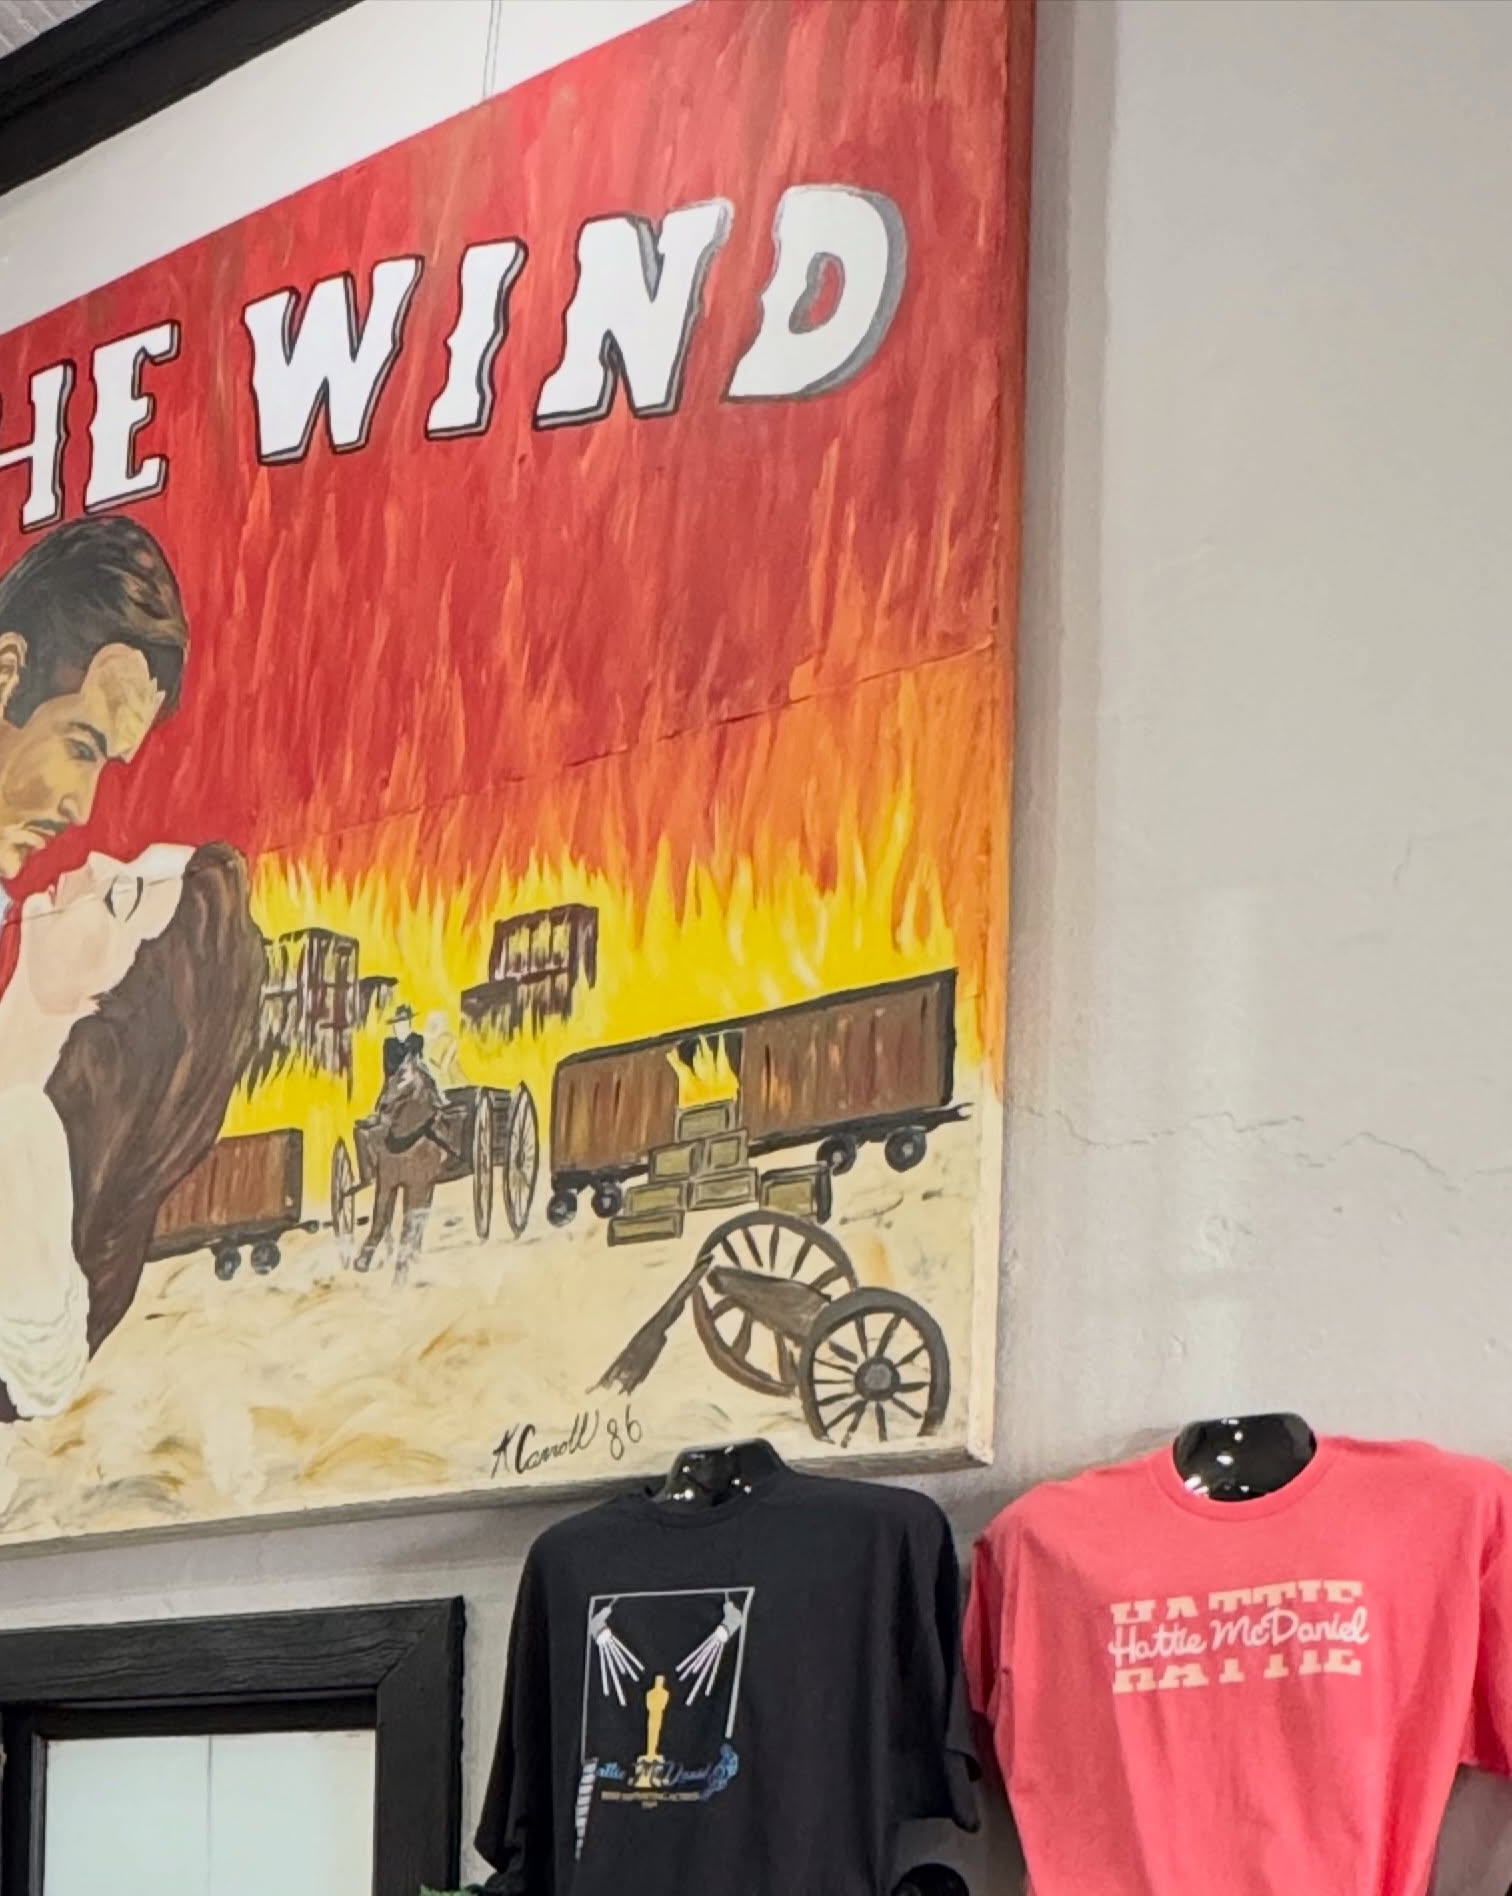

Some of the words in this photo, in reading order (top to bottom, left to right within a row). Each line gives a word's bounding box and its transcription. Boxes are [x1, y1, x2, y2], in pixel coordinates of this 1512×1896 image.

[244, 182, 908, 466] WIND
[1108, 1623, 1206, 1667] Hattie
[1211, 1606, 1369, 1650] McDaniel
